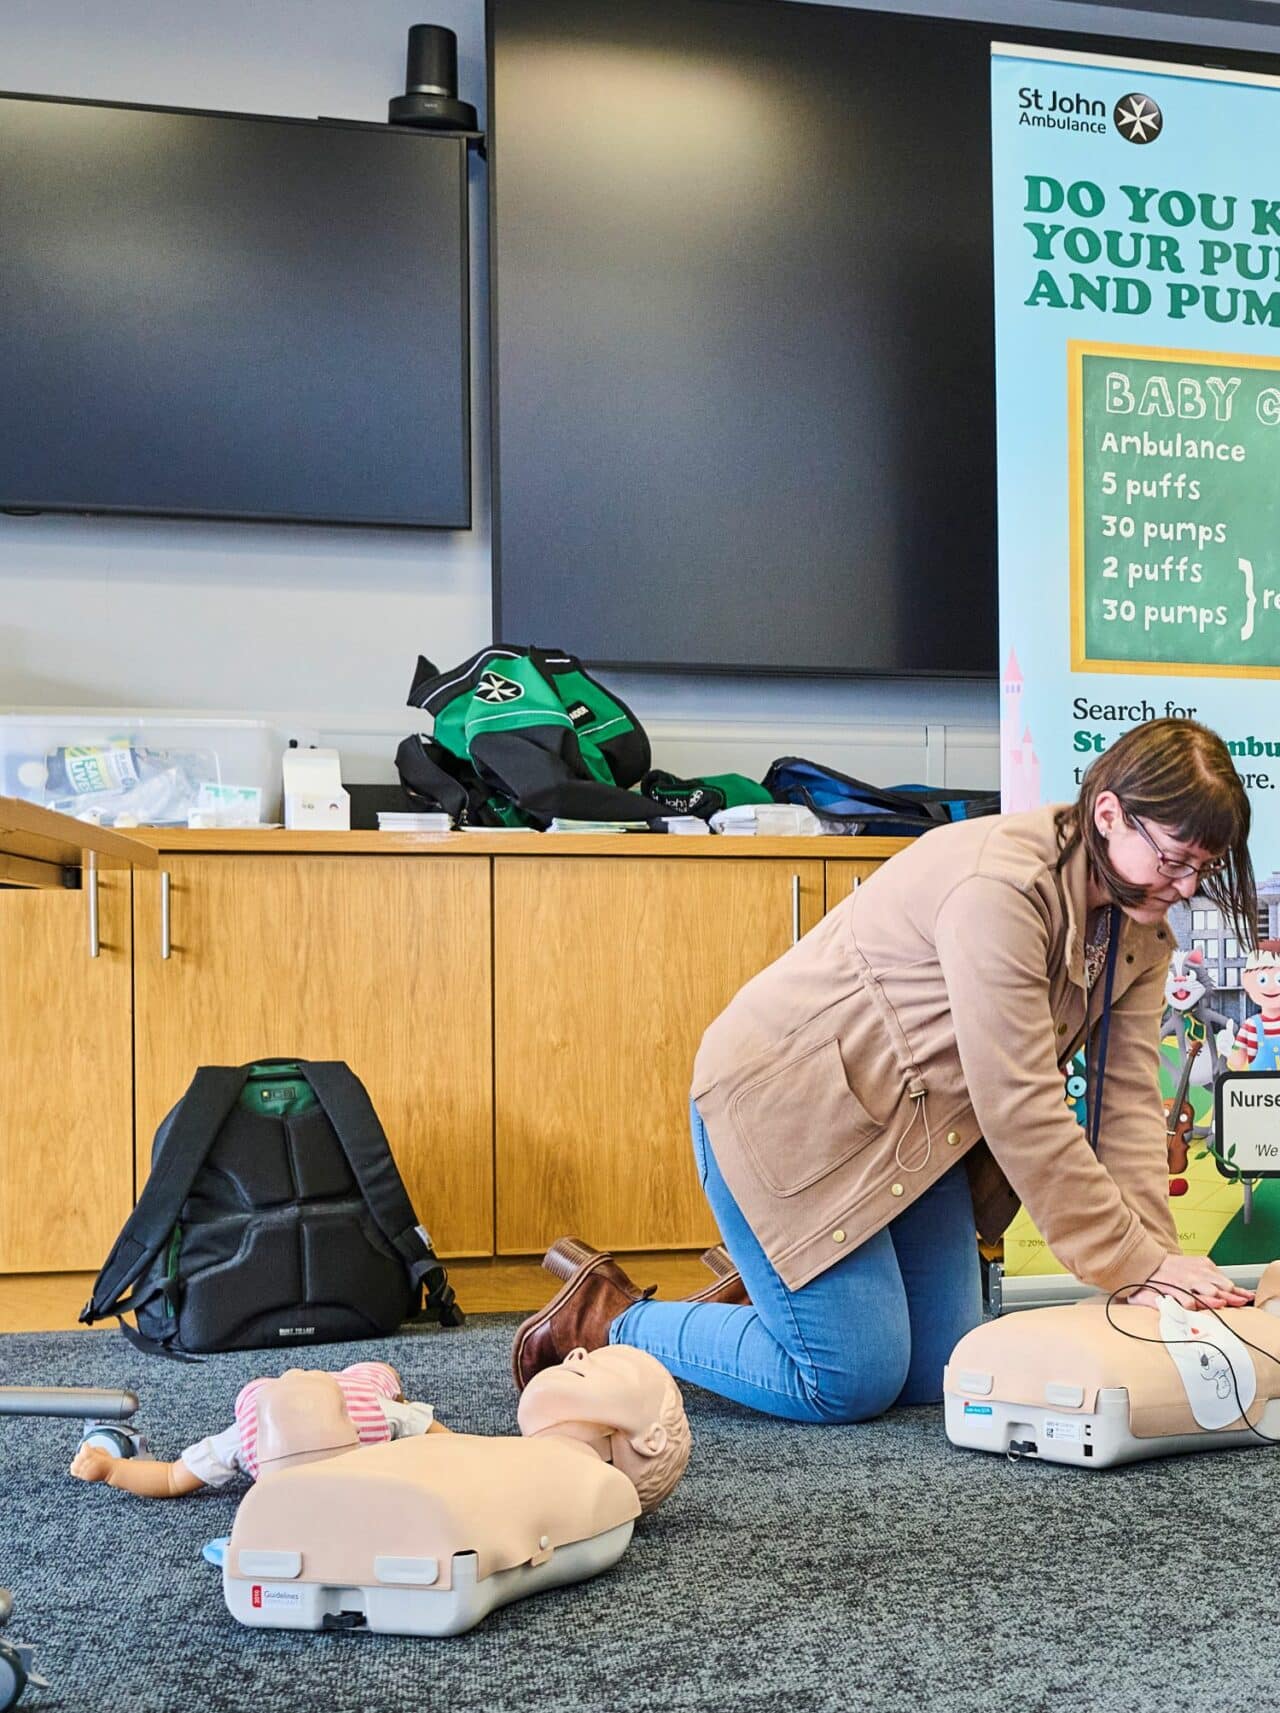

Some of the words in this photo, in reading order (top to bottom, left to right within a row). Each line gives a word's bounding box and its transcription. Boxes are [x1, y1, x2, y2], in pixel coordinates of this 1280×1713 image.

[1018, 87, 1044, 111] St
[1048, 90, 1106, 117] John
[1018, 111, 1106, 134] Ambulance
[1023, 175, 1105, 218] DO
[1119, 185, 1237, 231] YOU
[1023, 222, 1185, 274] YOUR
[1023, 270, 1151, 315] AND
[1106, 372, 1242, 421] BABY
[1101, 431, 1246, 462] Ambulance
[1102, 471, 1117, 495] 5
[1126, 473, 1201, 504] puffs
[1101, 515, 1135, 538] 30
[1143, 521, 1227, 550] pumps
[1102, 556, 1118, 578] 2
[1128, 556, 1202, 588] puffs
[1102, 598, 1136, 622] 30
[1144, 604, 1228, 633] pumps
[1073, 697, 1156, 721] Search
[1164, 701, 1197, 720] for
[1073, 730, 1106, 753] St
[1073, 767, 1083, 785] t
[1239, 773, 1275, 790] re.
[1255, 1144, 1279, 1157] 'We
[264, 1590, 299, 1600] Guidelines
